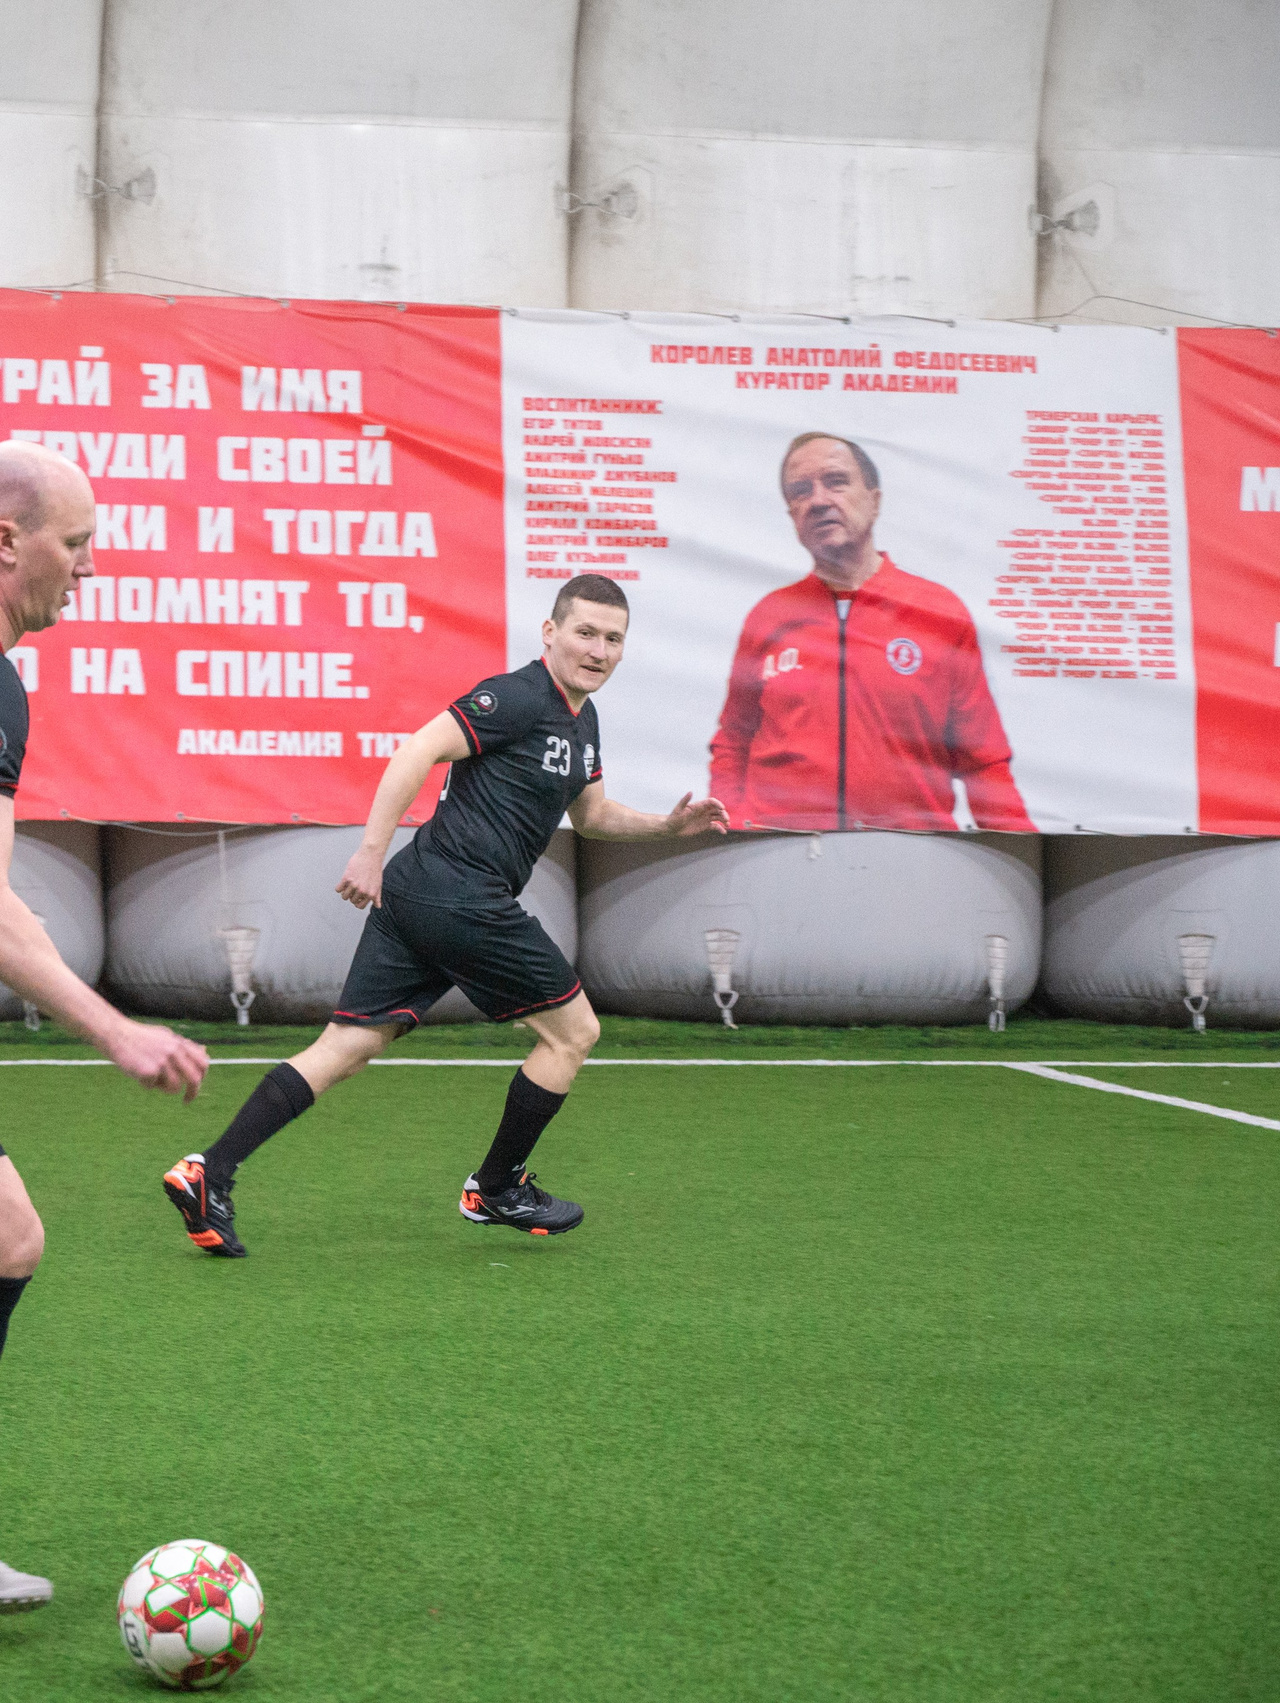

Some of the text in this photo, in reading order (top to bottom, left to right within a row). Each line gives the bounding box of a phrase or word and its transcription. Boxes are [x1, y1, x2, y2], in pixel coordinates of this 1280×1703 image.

[650, 343, 1038, 374] КОРОЛЕВ АНАТОЛИЙ ФЕДОСЕЕВИЧ
[735, 371, 959, 394] КУРАТОР АКАДЕМИИ
[140, 362, 212, 410] ЗА
[240, 365, 363, 414] ИМЯ
[217, 424, 393, 486] СВОЕЙ
[198, 506, 235, 553] И
[263, 508, 438, 558] ТОГДА
[338, 581, 425, 634] ТО,
[71, 647, 147, 695] НА
[176, 650, 370, 699] СПИНЕ.
[177, 729, 343, 757] АКАДЕМИЯ
[541, 735, 571, 777] 23
